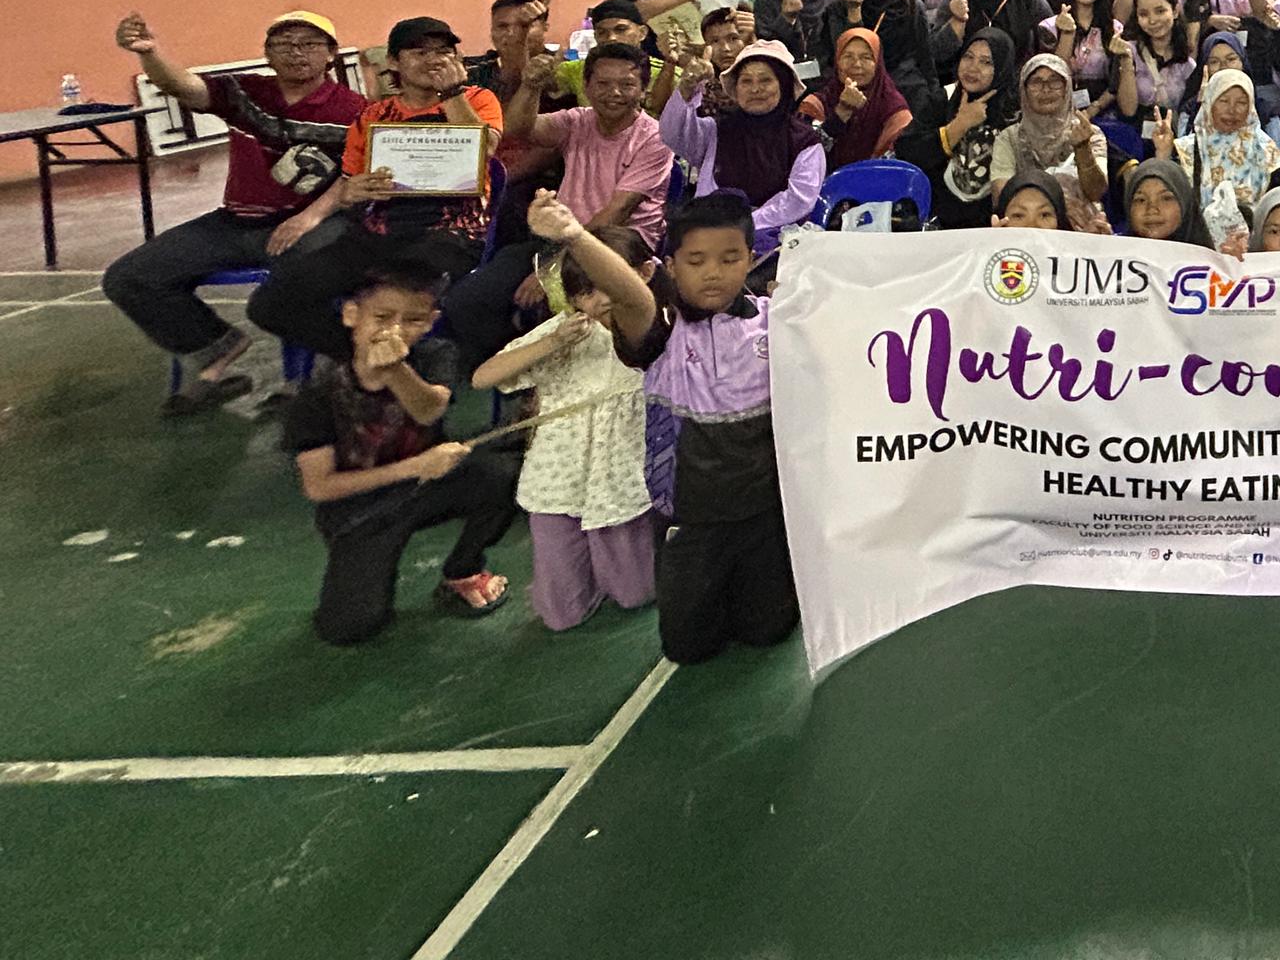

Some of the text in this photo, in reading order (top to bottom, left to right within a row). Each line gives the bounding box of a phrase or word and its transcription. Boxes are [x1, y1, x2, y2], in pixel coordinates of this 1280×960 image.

[1048, 256, 1149, 294] UMS
[1089, 298, 1125, 306] MALAYSIA
[857, 420, 1090, 462] EMPOWERING
[1043, 470, 1191, 502] HEALTHY
[1093, 513, 1257, 522] NUTRITION PROGRAMME
